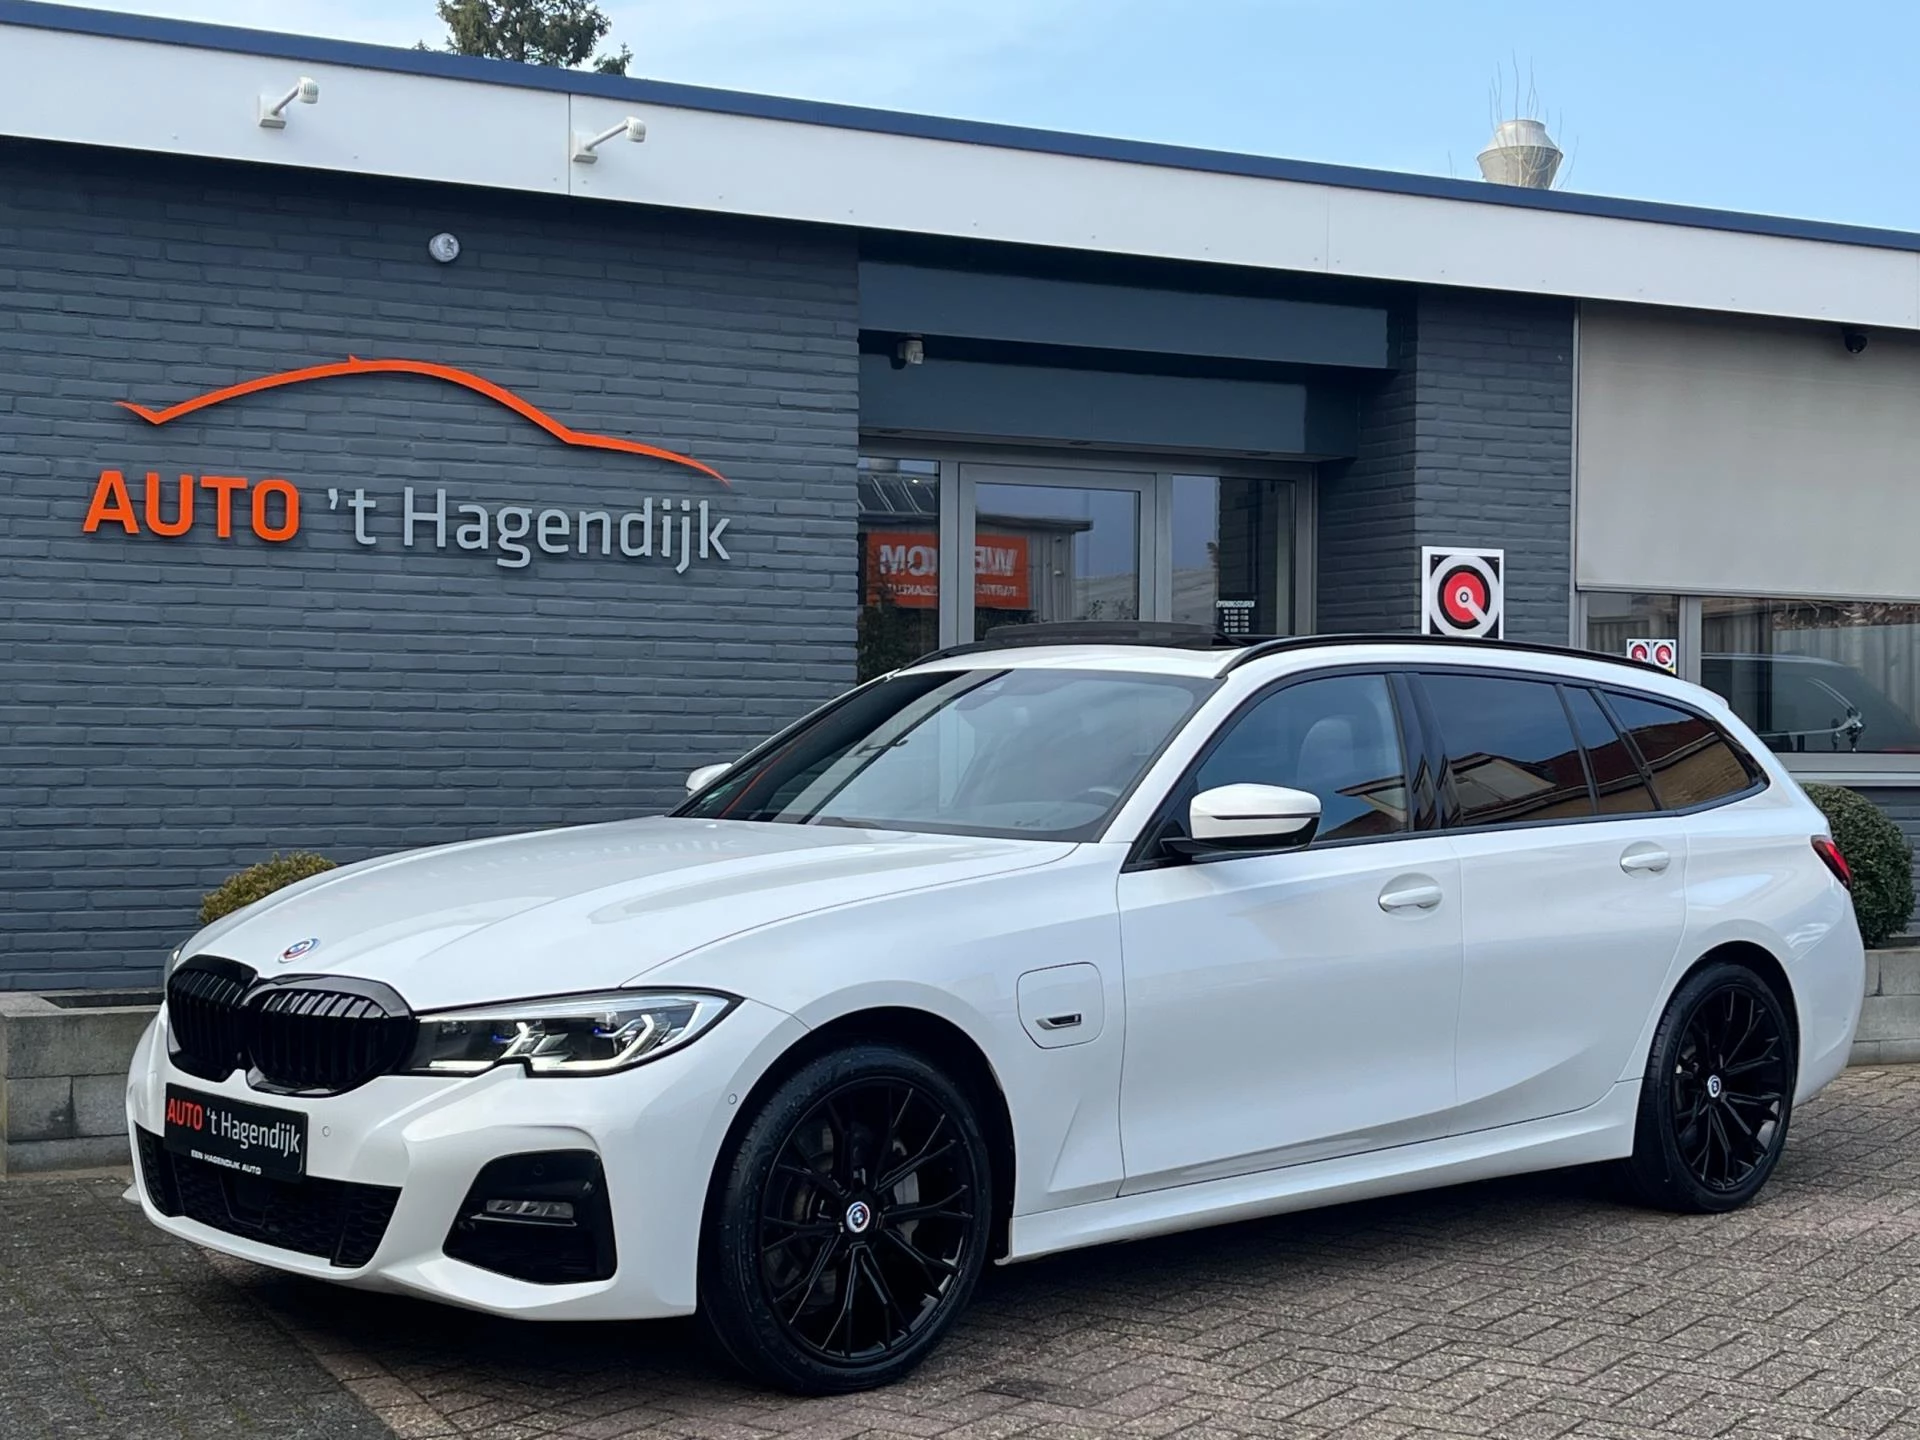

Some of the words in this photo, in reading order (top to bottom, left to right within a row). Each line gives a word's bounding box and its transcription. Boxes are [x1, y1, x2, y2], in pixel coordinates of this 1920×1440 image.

[83, 470, 301, 542] AUTO
[403, 486, 731, 574] Hagendijk
[167, 1098, 203, 1131] AUTO
[220, 1112, 301, 1158] Hagendijk
[241, 1163, 262, 1176] AUTO
